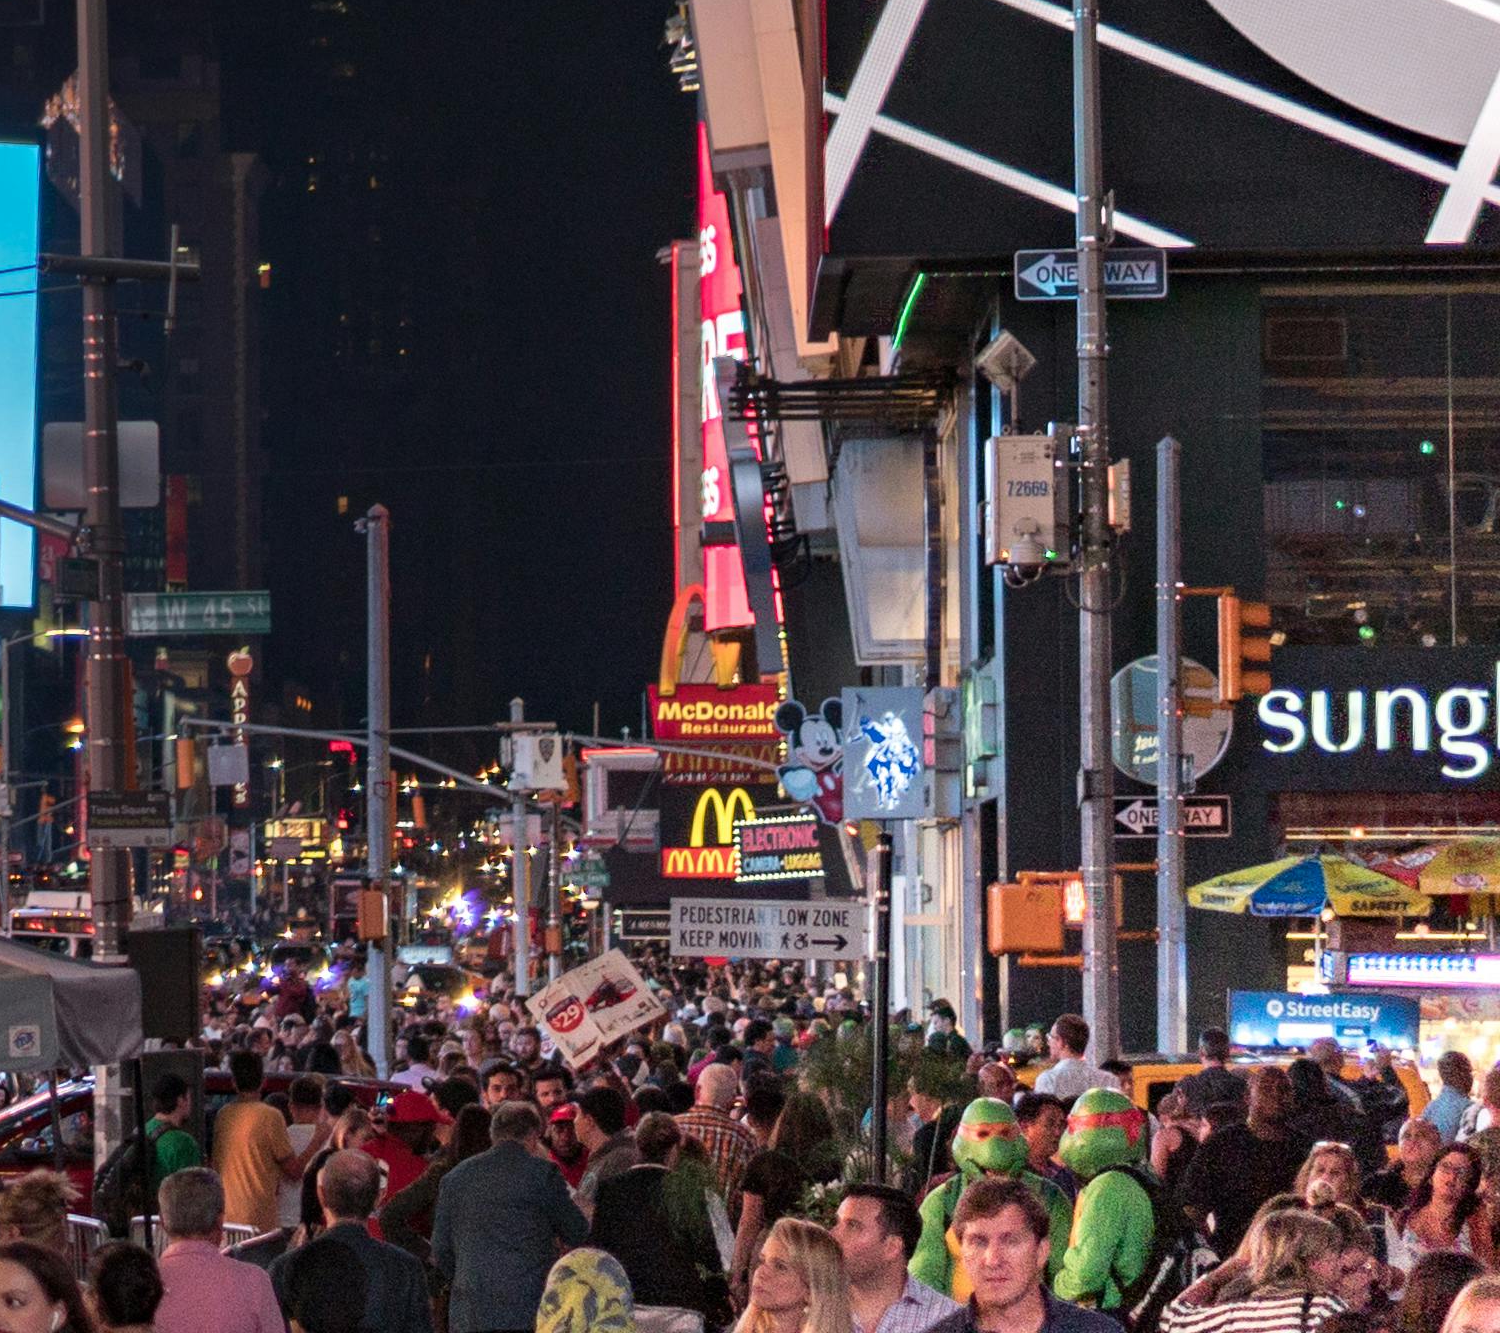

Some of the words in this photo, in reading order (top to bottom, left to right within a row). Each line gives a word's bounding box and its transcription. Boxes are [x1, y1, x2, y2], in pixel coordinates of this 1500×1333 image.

[1103, 264, 1151, 284] WAY
[164, 600, 189, 630] W
[204, 598, 234, 629] 45
[681, 722, 774, 735] Restaurant
[1257, 661, 1500, 780] sung
[679, 905, 763, 926] PEDESTRIAN
[767, 906, 810, 927] FLOW
[812, 907, 850, 928] ZONE
[679, 929, 716, 948] KEEP
[718, 929, 774, 949] MOVING
[1285, 1000, 1381, 1022] StreetEasy
